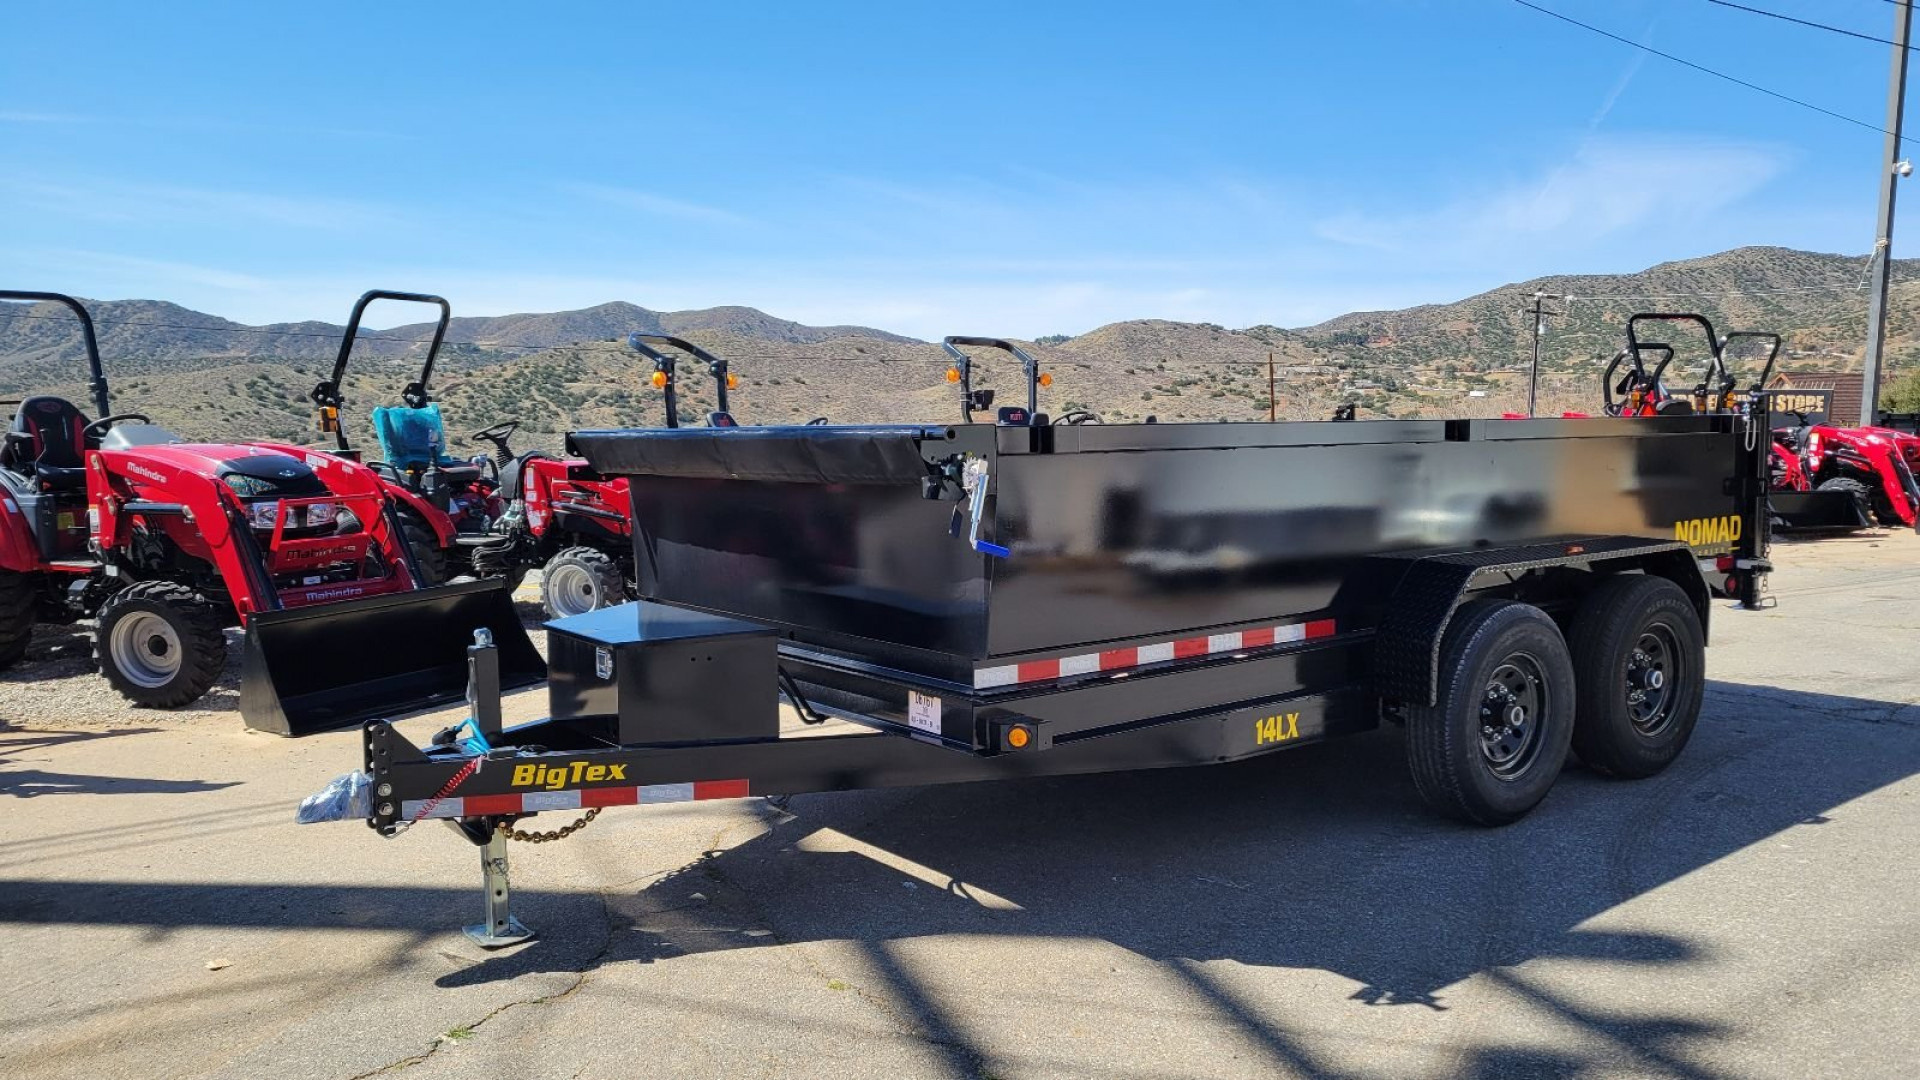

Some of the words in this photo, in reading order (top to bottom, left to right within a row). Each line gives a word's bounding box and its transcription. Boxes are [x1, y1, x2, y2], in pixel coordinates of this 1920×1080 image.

[127, 461, 167, 483] Mahindra
[1675, 515, 1742, 547] NOMAD
[305, 587, 363, 601] Mahindra
[1255, 712, 1300, 745] 14LX
[511, 761, 628, 789] BigTex
